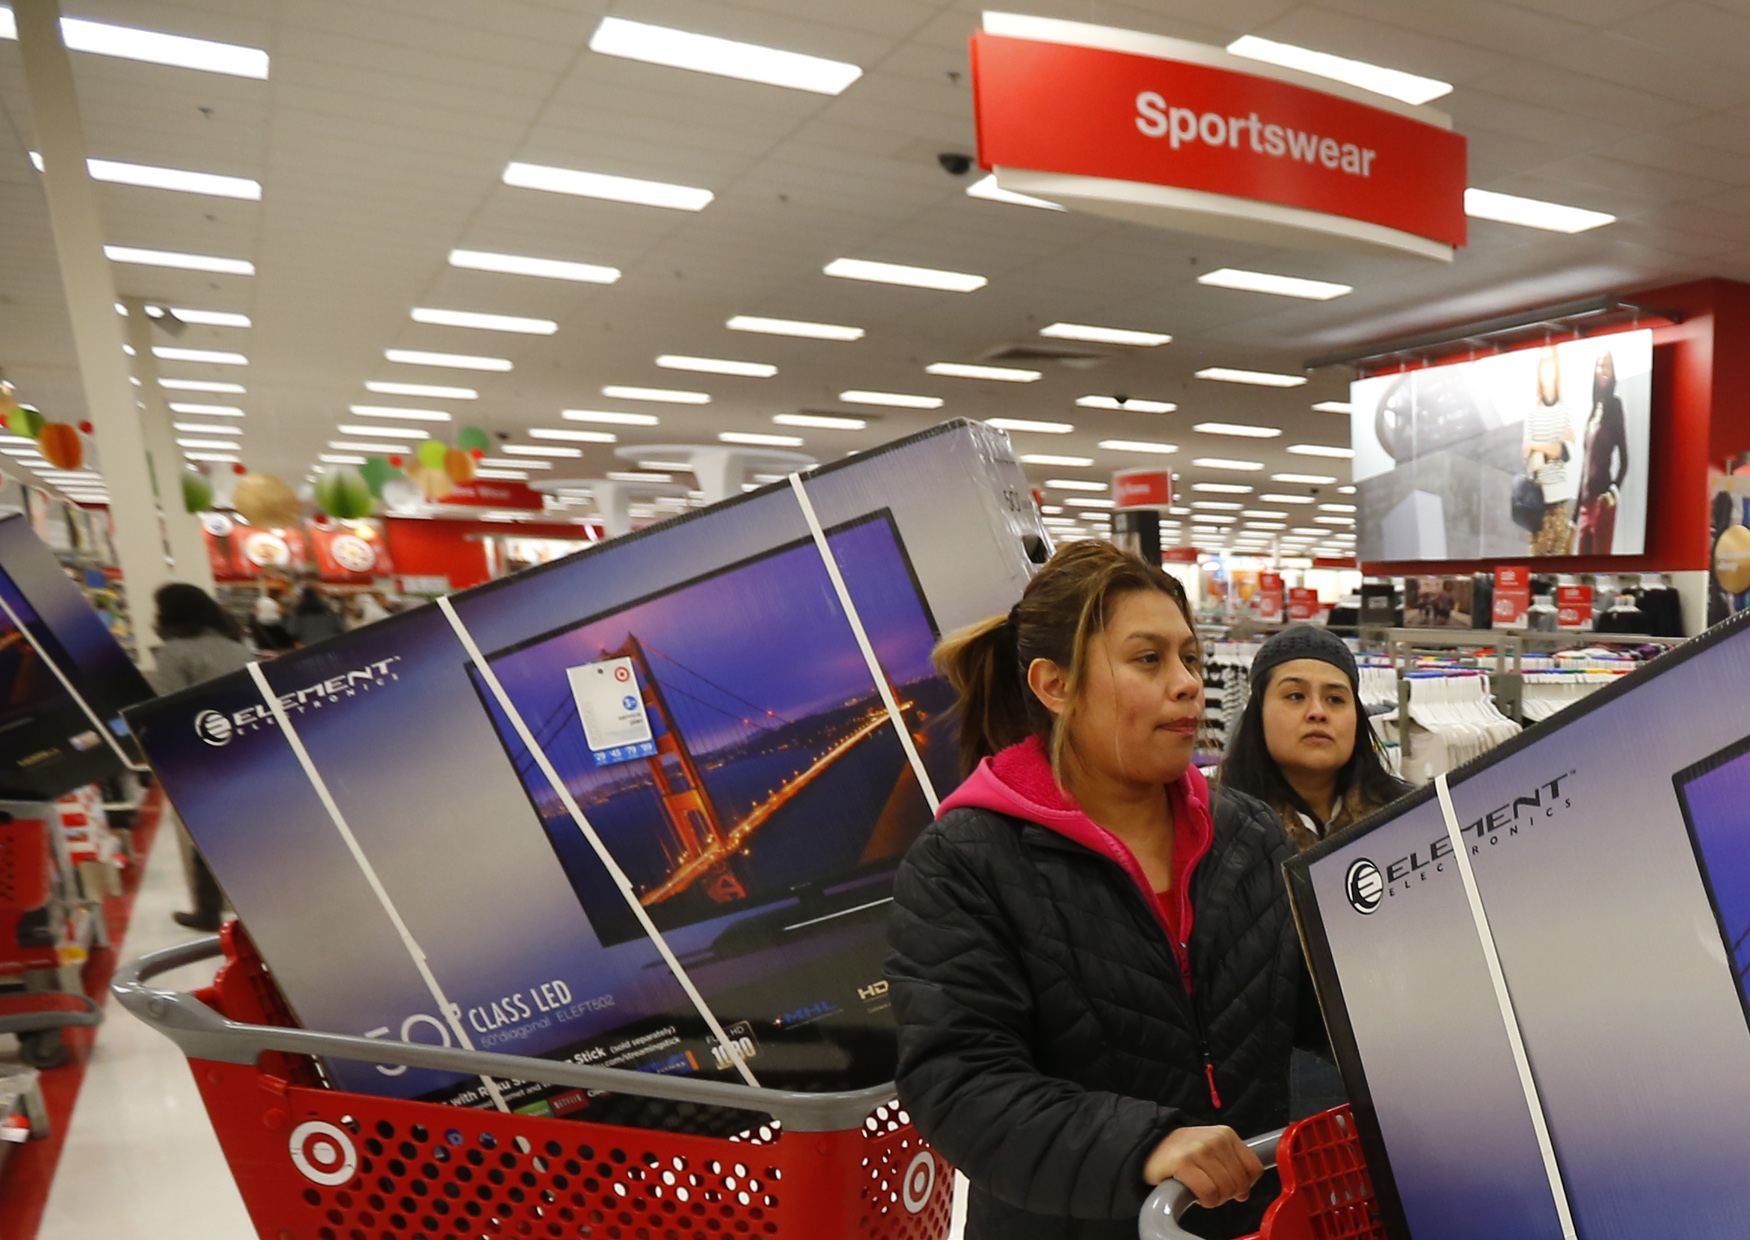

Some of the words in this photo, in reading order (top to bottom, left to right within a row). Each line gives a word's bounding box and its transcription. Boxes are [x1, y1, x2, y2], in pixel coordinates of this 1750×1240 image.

[1135, 91, 1376, 177] Sportswear
[1389, 798, 1572, 897] ELECRONICS
[469, 993, 531, 1033] CLASS
[530, 979, 573, 1013] LED
[783, 1001, 838, 1023] MHL
[729, 1026, 745, 1036] HD
[573, 1046, 607, 1065] Stick
